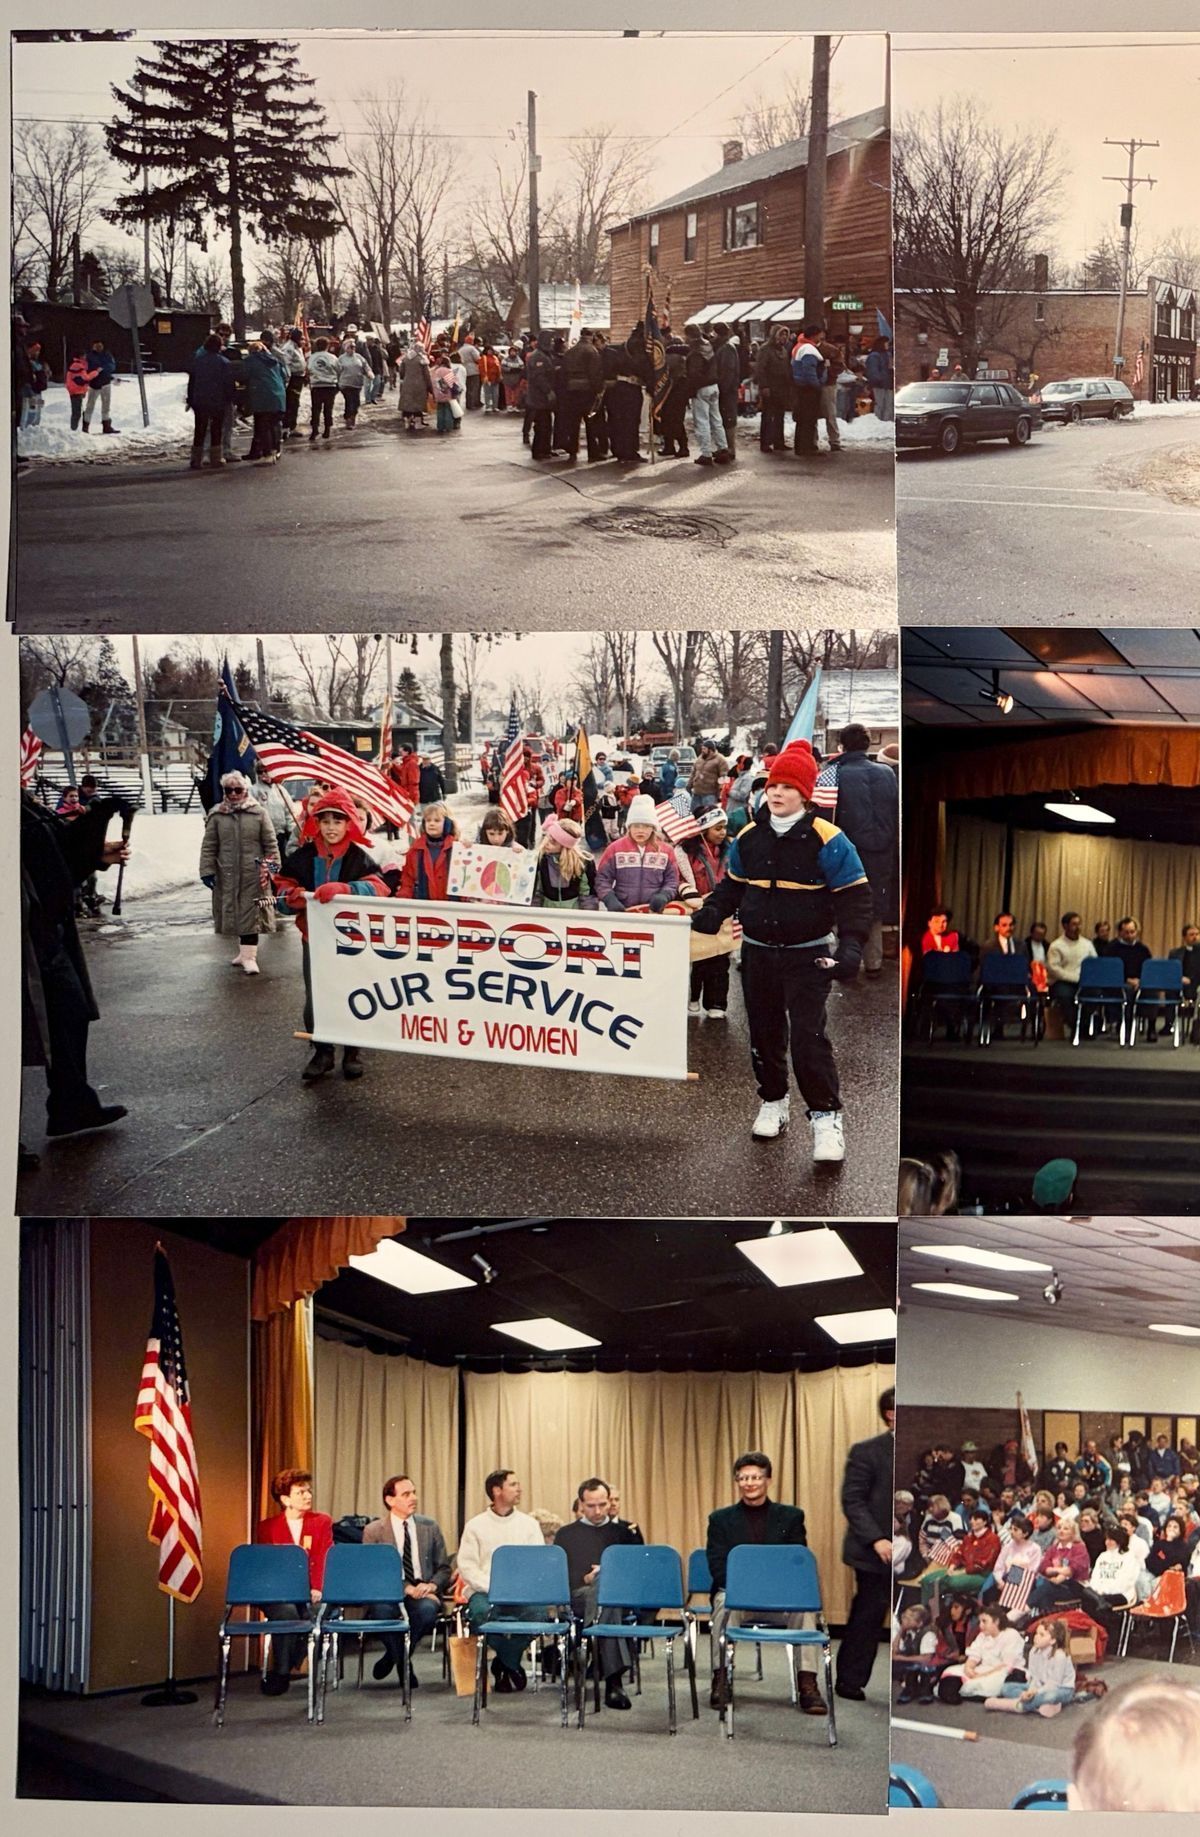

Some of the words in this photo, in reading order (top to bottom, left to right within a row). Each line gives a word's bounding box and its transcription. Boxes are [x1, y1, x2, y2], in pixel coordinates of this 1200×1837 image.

[333, 911, 655, 979] SUPPORT
[348, 972, 434, 1021] OUR
[445, 968, 644, 1051] SERVICE
[401, 1013, 448, 1044] MEN
[457, 1019, 475, 1045] &
[484, 1021, 578, 1057] WOMEN
